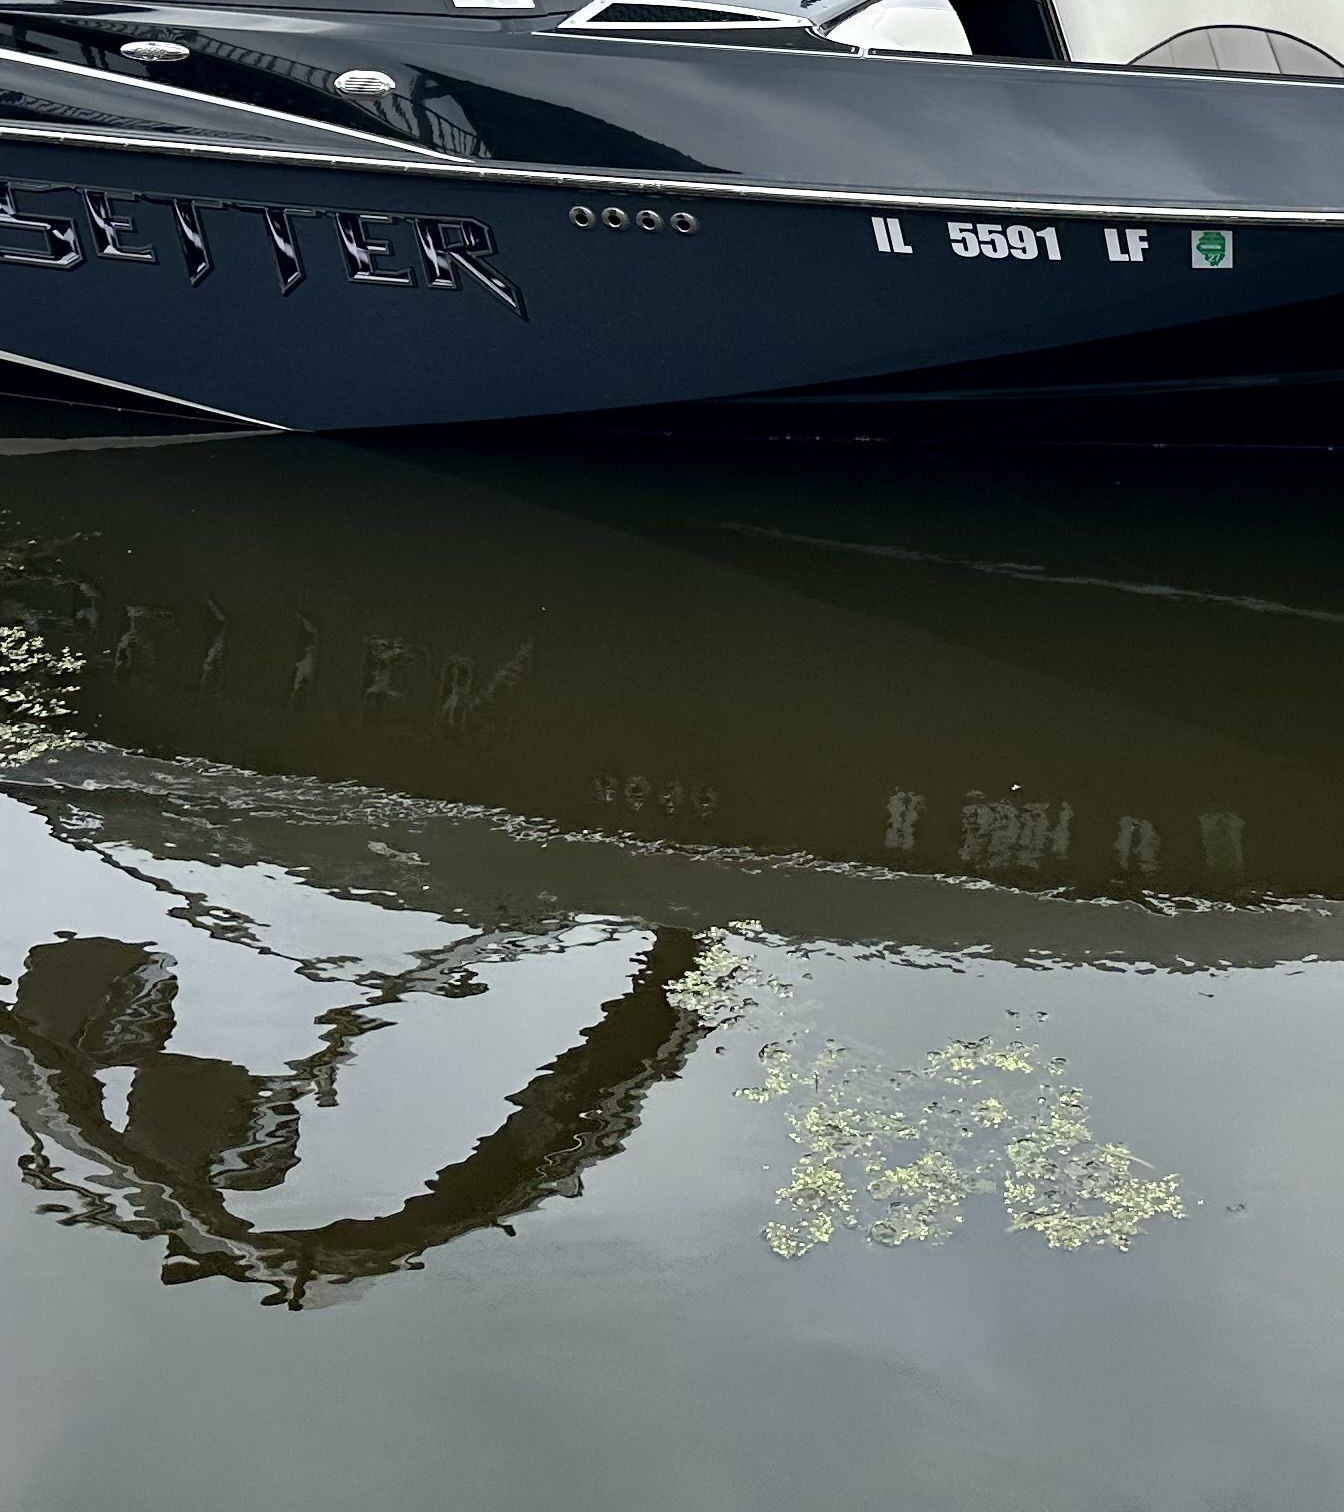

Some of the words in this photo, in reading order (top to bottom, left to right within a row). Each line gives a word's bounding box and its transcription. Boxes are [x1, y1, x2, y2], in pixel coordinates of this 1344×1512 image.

[871, 216, 913, 254] IL
[947, 221, 1062, 260] 5591
[1104, 228, 1149, 262] LF
